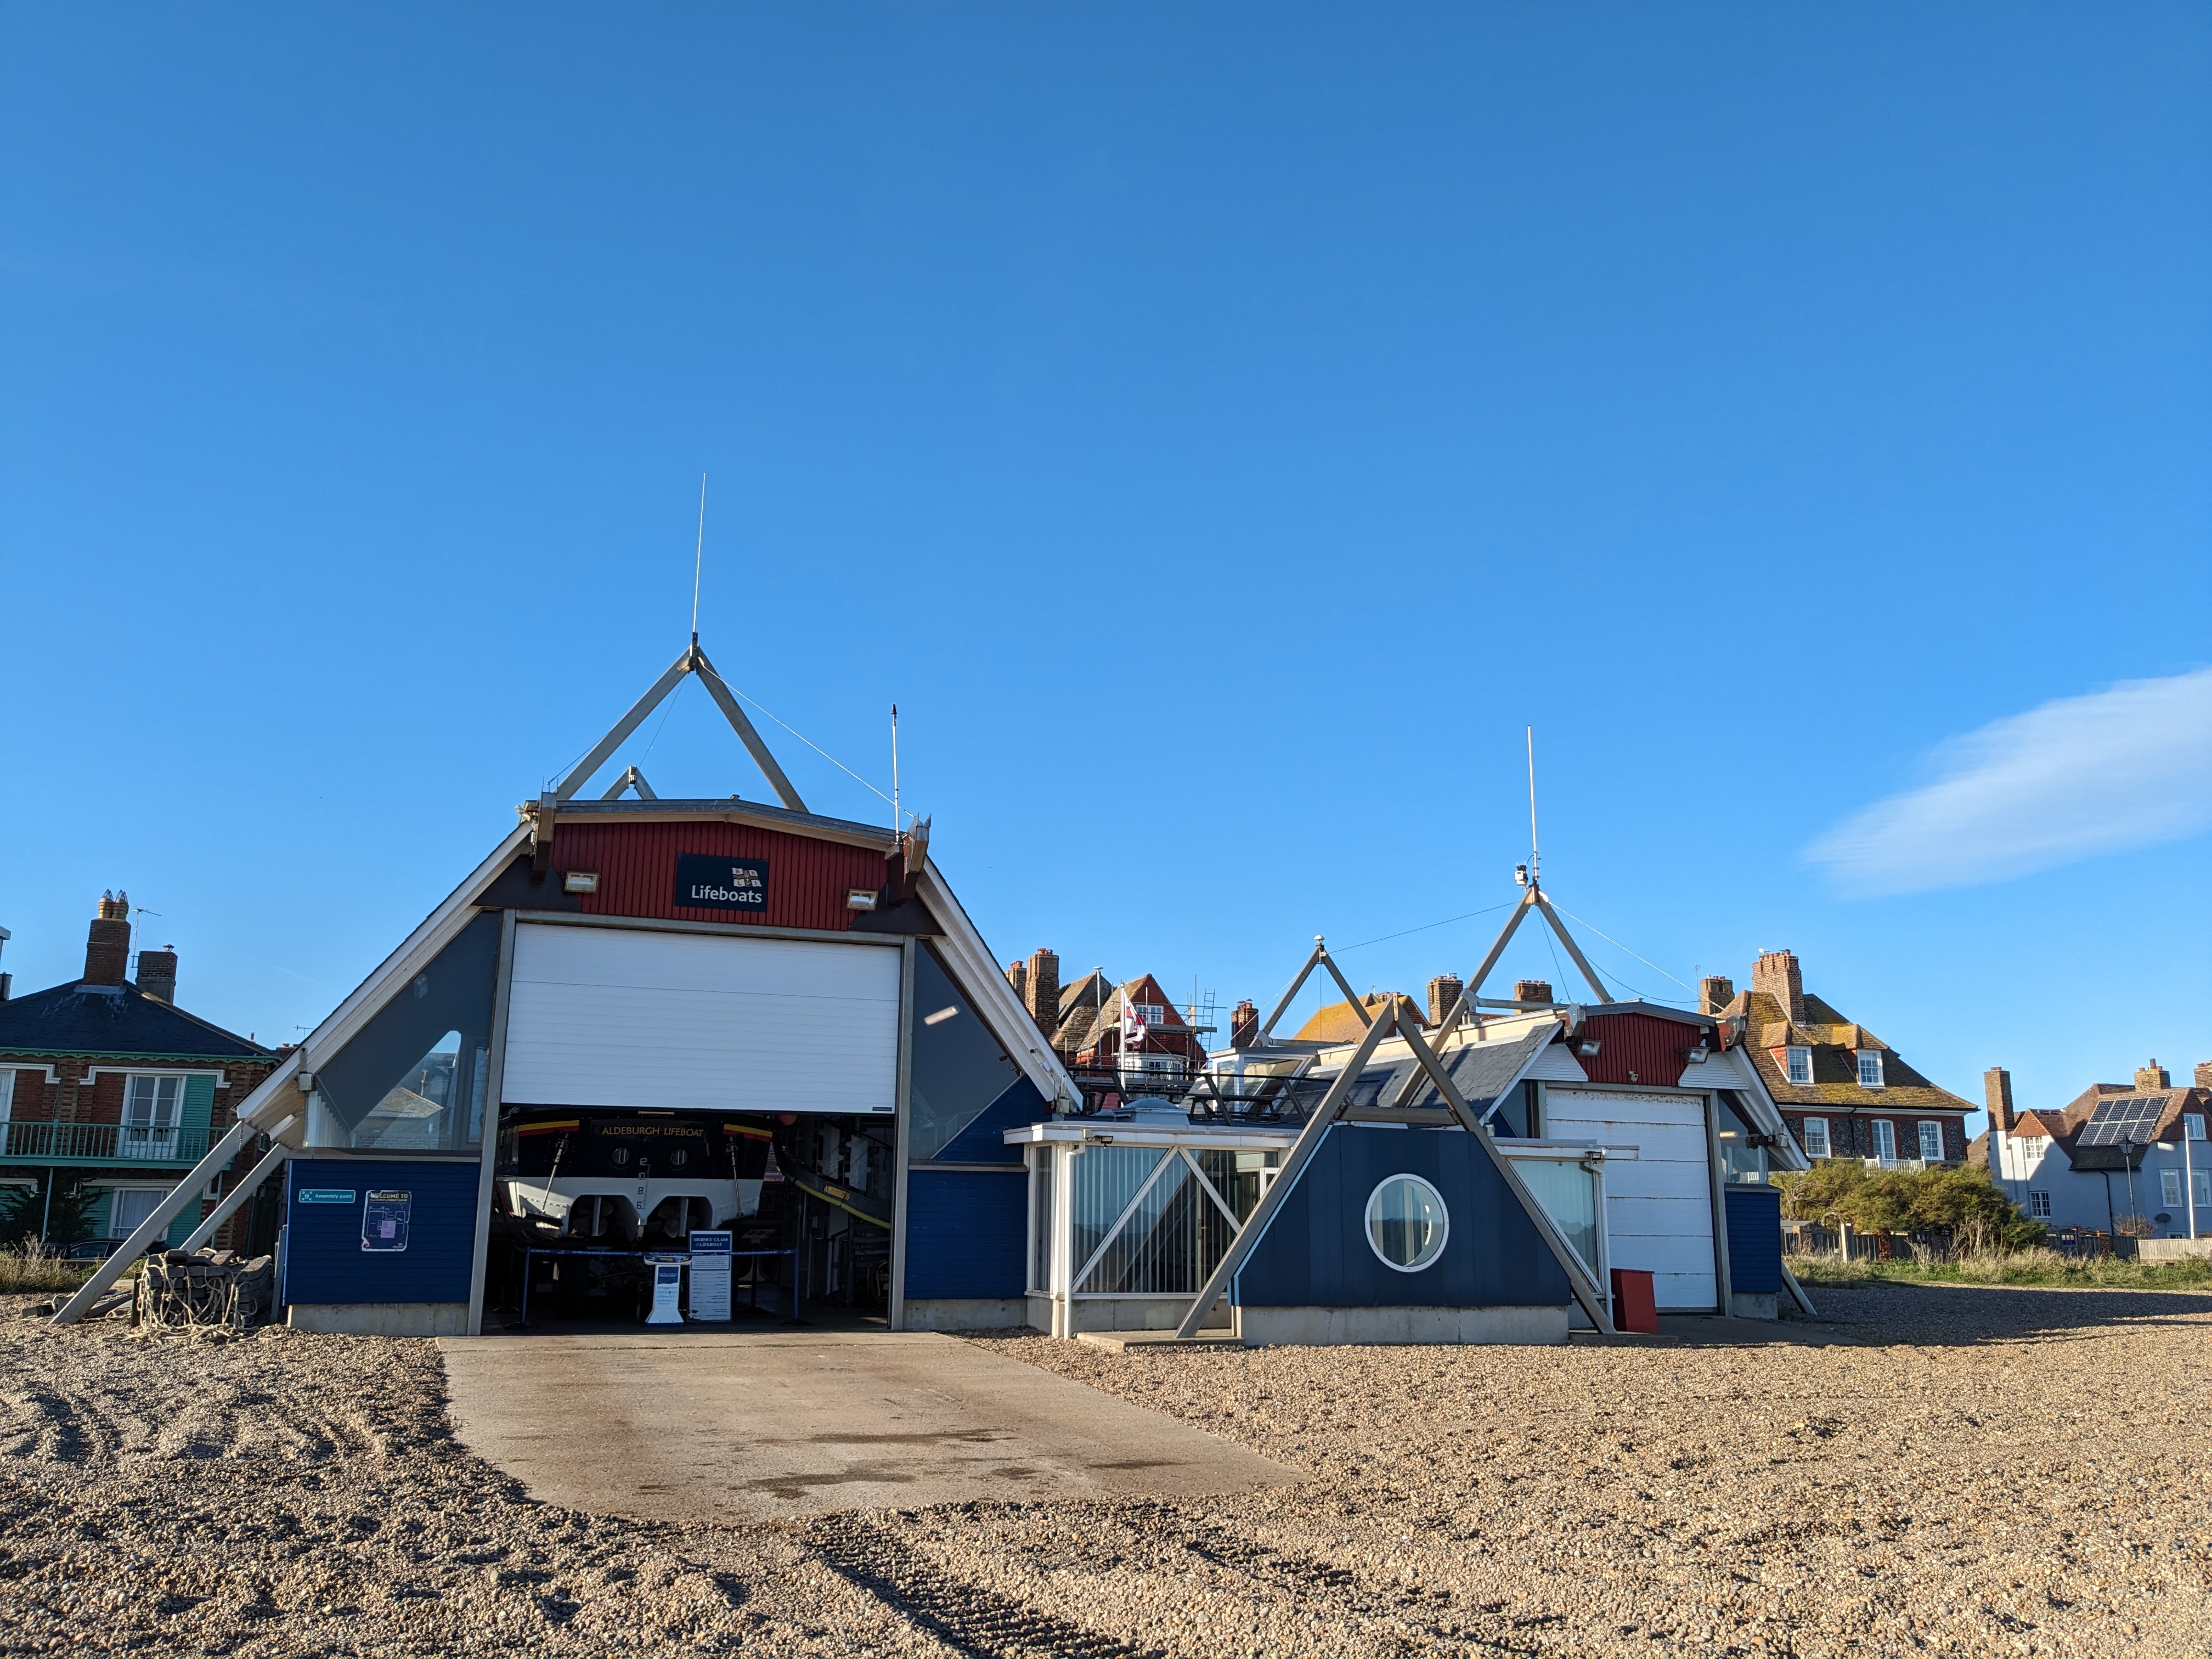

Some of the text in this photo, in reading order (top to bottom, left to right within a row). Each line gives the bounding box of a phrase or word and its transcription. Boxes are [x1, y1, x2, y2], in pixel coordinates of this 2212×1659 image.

[691, 884, 762, 903] Lifeboats
[602, 1126, 704, 1137] ALDEBURGH LIFEBOAT
[639, 1158, 647, 1166] 12
[636, 1201, 642, 1209] 6
